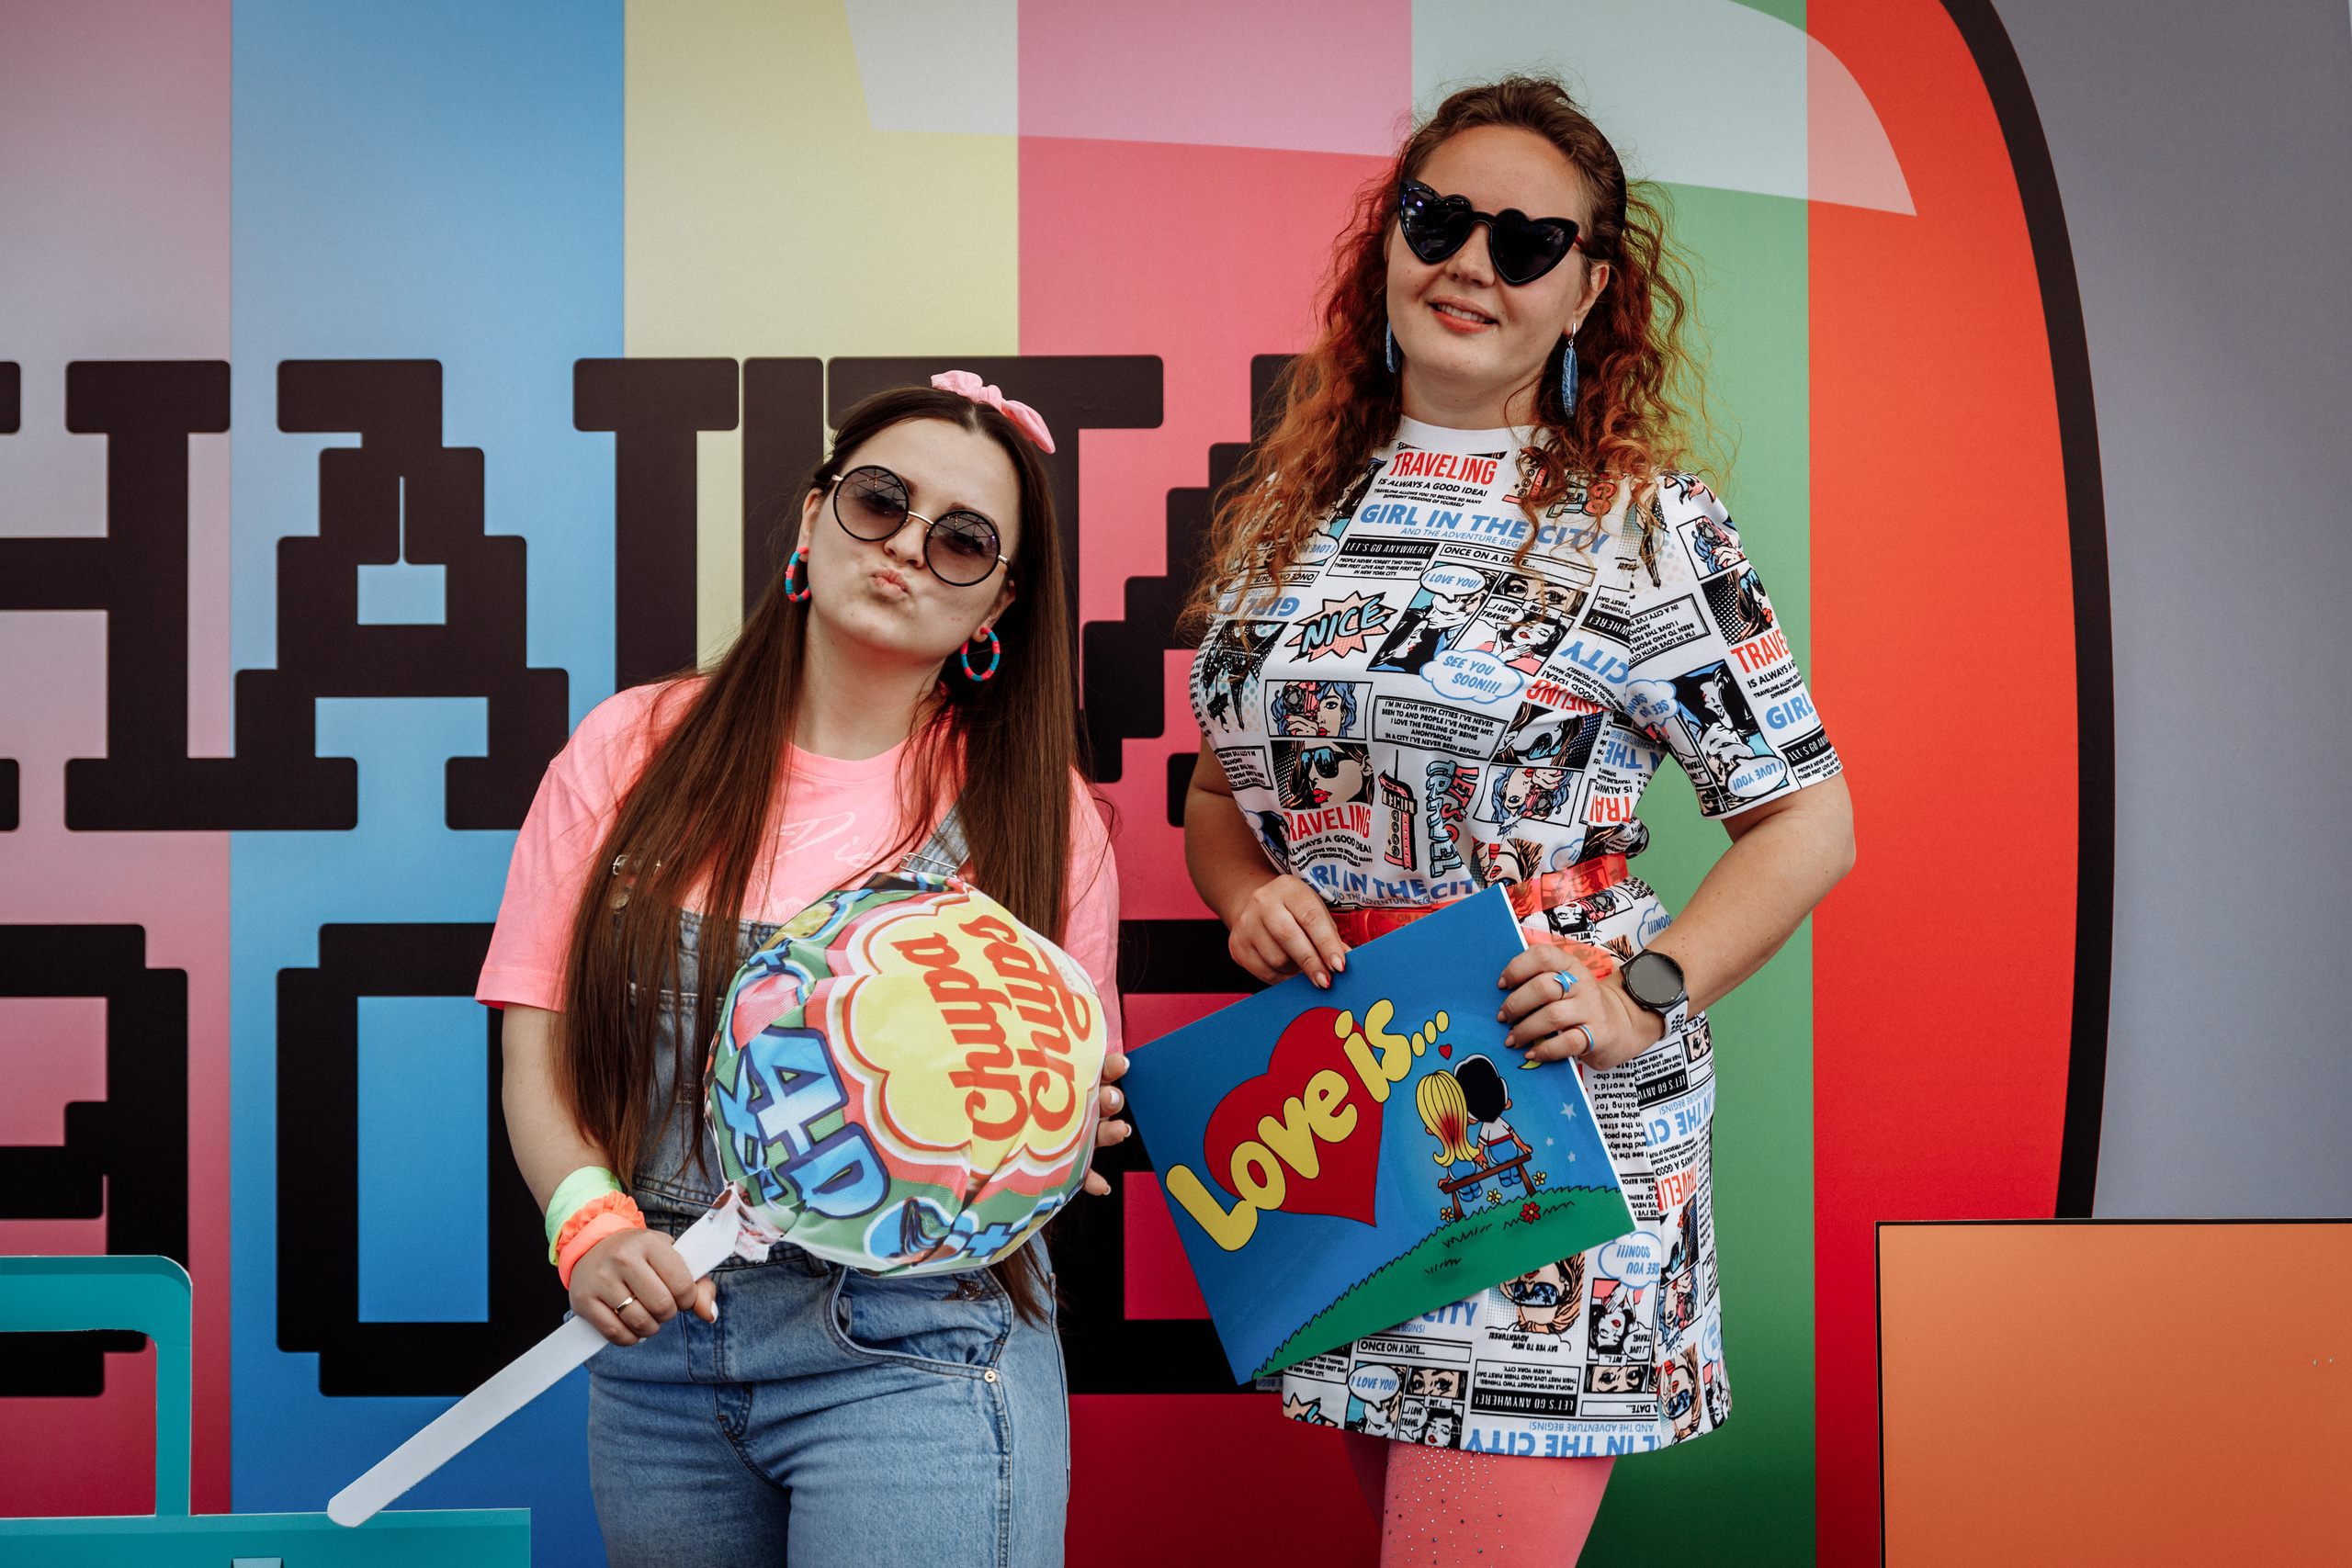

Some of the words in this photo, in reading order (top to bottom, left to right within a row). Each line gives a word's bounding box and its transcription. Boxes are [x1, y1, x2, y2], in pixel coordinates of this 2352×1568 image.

[1389, 452, 1498, 485] TRAVELING
[1387, 479, 1423, 489] ALWAYS
[1432, 483, 1460, 492] GOOD
[1462, 487, 1487, 496] IDEA!
[1360, 503, 1419, 525] GIRL
[1426, 510, 1463, 529] IN
[1470, 514, 1529, 540] THE
[1536, 525, 1610, 554] CITY
[1423, 529, 1440, 537] THE
[1441, 530, 1498, 544] ADVENTURE
[1501, 536, 1538, 551] BEGIS!
[1345, 543, 1370, 551] LET'S
[1370, 544, 1382, 552] GO
[1383, 544, 1433, 555] ANYWHERE!
[1444, 547, 1471, 556] ONCE
[1473, 550, 1489, 559] ON
[1491, 554, 1501, 563] A
[1501, 556, 1535, 569] DAE...
[1430, 574, 1455, 584] LOVE
[1456, 577, 1481, 589] YOU!
[1498, 604, 1520, 615] LOVE
[1302, 597, 1386, 653] NICE
[1442, 656, 1467, 668] SEE
[1471, 660, 1495, 676] YOU
[1559, 641, 1629, 683] CITY
[1452, 672, 1502, 694] SOON!!!
[1747, 681, 1758, 689] IS
[1758, 665, 1789, 684] ALWAYS
[1754, 683, 1780, 698] TRAVELING
[1403, 703, 1419, 711] LOVE
[1419, 705, 1436, 714] WITH
[1439, 709, 1458, 719] CITIES
[1459, 715, 1472, 723] I'VE
[1473, 717, 1494, 728] NEVER
[1766, 693, 1814, 729] GIRL
[1420, 715, 1443, 724] PEOPLE
[1458, 722, 1479, 733] NEVER
[1480, 728, 1495, 737] MET.
[1422, 724, 1448, 733] FEELING
[1459, 729, 1477, 740] BEING
[1411, 728, 1453, 742] ANONYMOUS
[1421, 739, 1442, 747] NEVER
[1442, 742, 1457, 750] BEEN
[1459, 746, 1481, 756] BEFORE
[1788, 746, 1808, 761] LET'S
[1808, 742, 1817, 752] GO
[1754, 763, 1775, 779] LOVE
[1734, 773, 1754, 792] YOU!
[1283, 805, 1371, 841] RAVELING
[1334, 835, 1355, 846] GOOD
[1343, 869, 1367, 895] IN
[1373, 878, 1428, 899] THE
[1362, 896, 1411, 906] ADVENTURE
[959, 915, 1091, 1133] Chups
[890, 932, 1029, 1141] Chupa
[1658, 1082, 1667, 1094] GO
[1669, 1074, 1686, 1091] LET'S
[1166, 1069, 1359, 1251] Love
[1334, 998, 1450, 1104] is...
[1675, 1102, 1702, 1136] THE
[1616, 1245, 1650, 1258] SOON!!!
[1626, 1262, 1644, 1275] YOU
[1488, 1332, 1529, 1342] ADVENTURES!
[1361, 1341, 1385, 1352] ONCE
[1387, 1344, 1397, 1352] ON
[1405, 1345, 1425, 1355] DATE...
[1535, 1344, 1546, 1352] YES
[1356, 1376, 1378, 1389] LOVE
[1379, 1378, 1396, 1391] YOU!
[1476, 1393, 1531, 1408] ANYWHERE!
[1534, 1399, 1546, 1409] GO
[1549, 1400, 1573, 1411] LET'S
[1410, 1405, 1422, 1416] LOVE
[1529, 1421, 1564, 1431] BEGINS!
[1566, 1423, 1617, 1432] ADVENTURE
[1619, 1424, 1634, 1432] THE
[1636, 1424, 1654, 1432] AND
[1464, 1428, 1536, 1456] CITY
[1544, 1435, 1597, 1457] THE
[1607, 1435, 1634, 1457] IN
